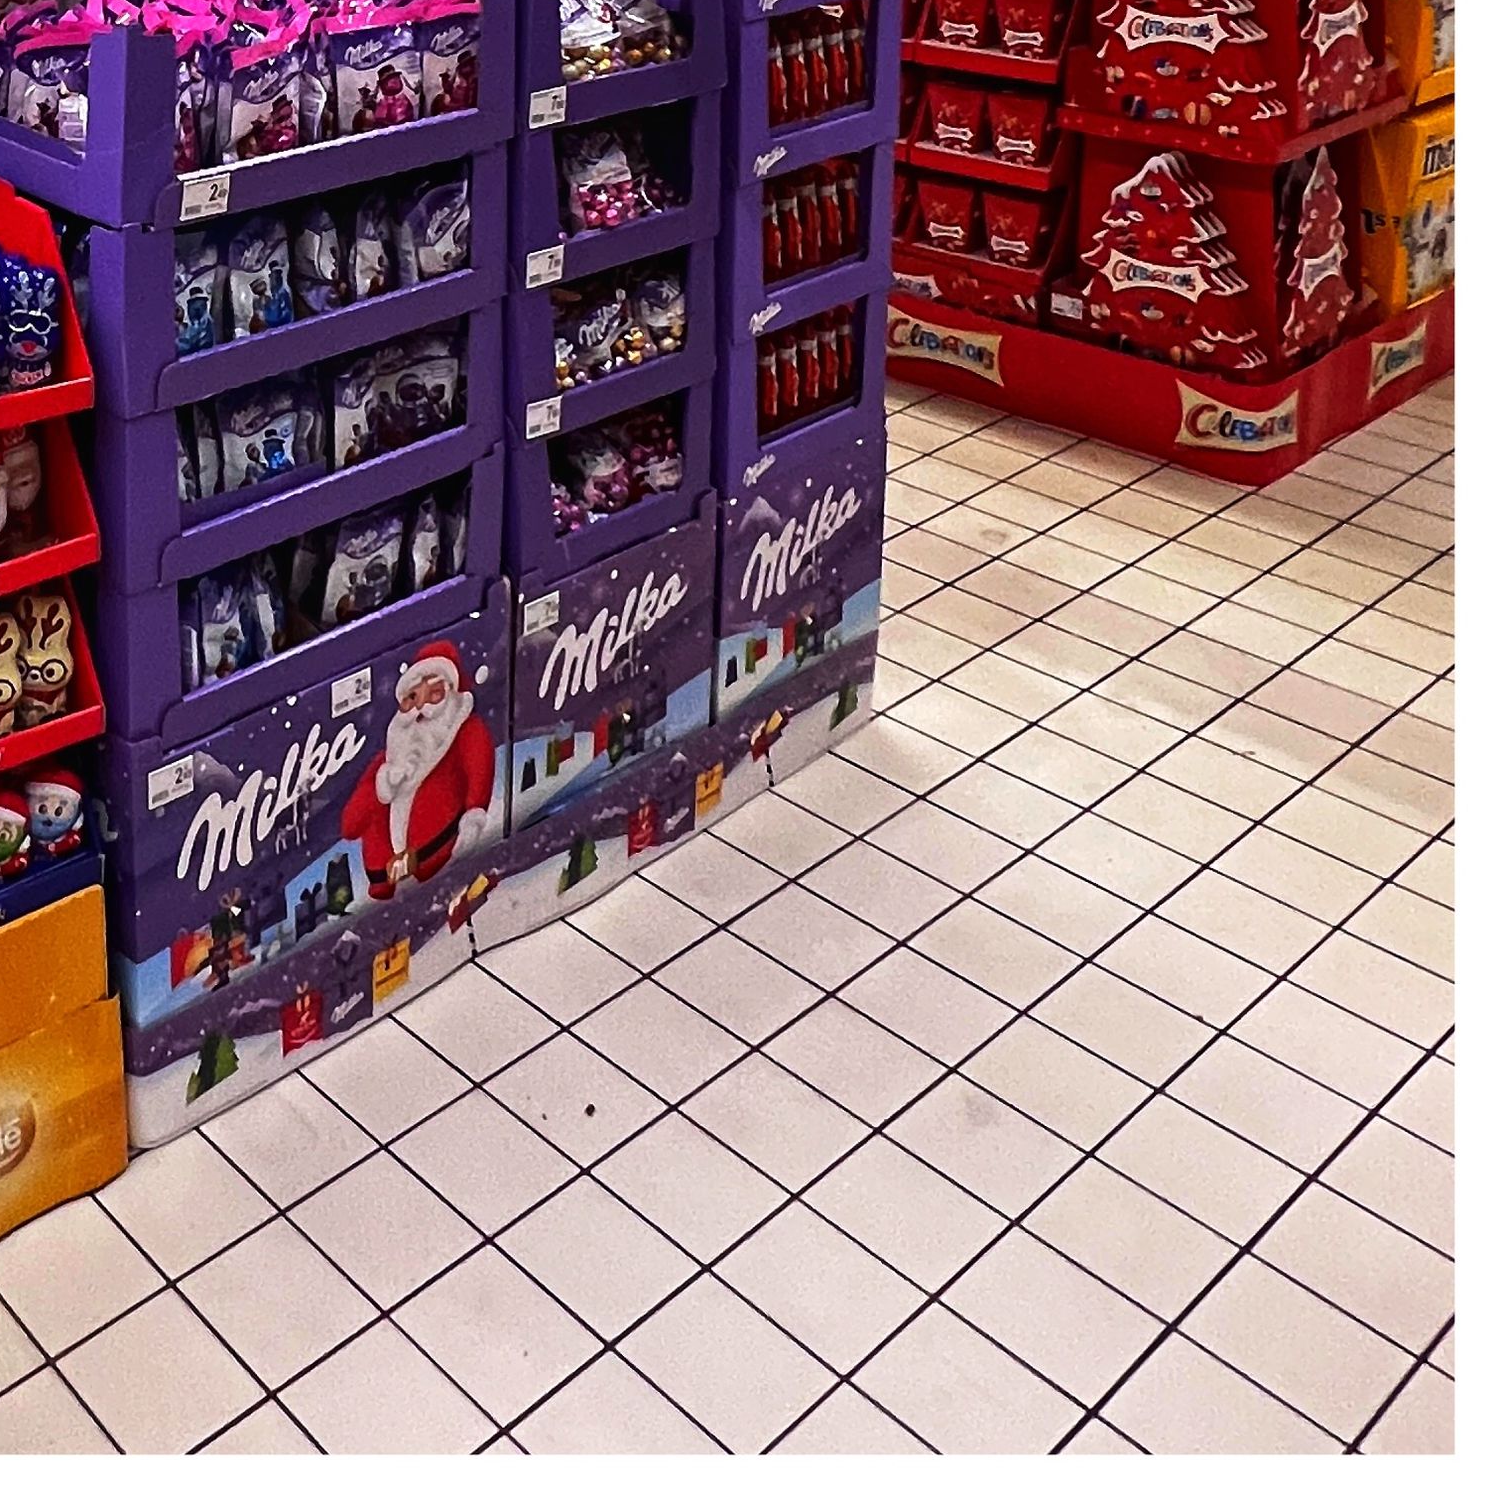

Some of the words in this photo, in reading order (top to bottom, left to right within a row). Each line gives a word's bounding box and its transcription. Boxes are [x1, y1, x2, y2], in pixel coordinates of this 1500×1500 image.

[740, 485, 863, 612] Milka
[537, 571, 689, 712] Milka
[176, 719, 367, 892] Milka
